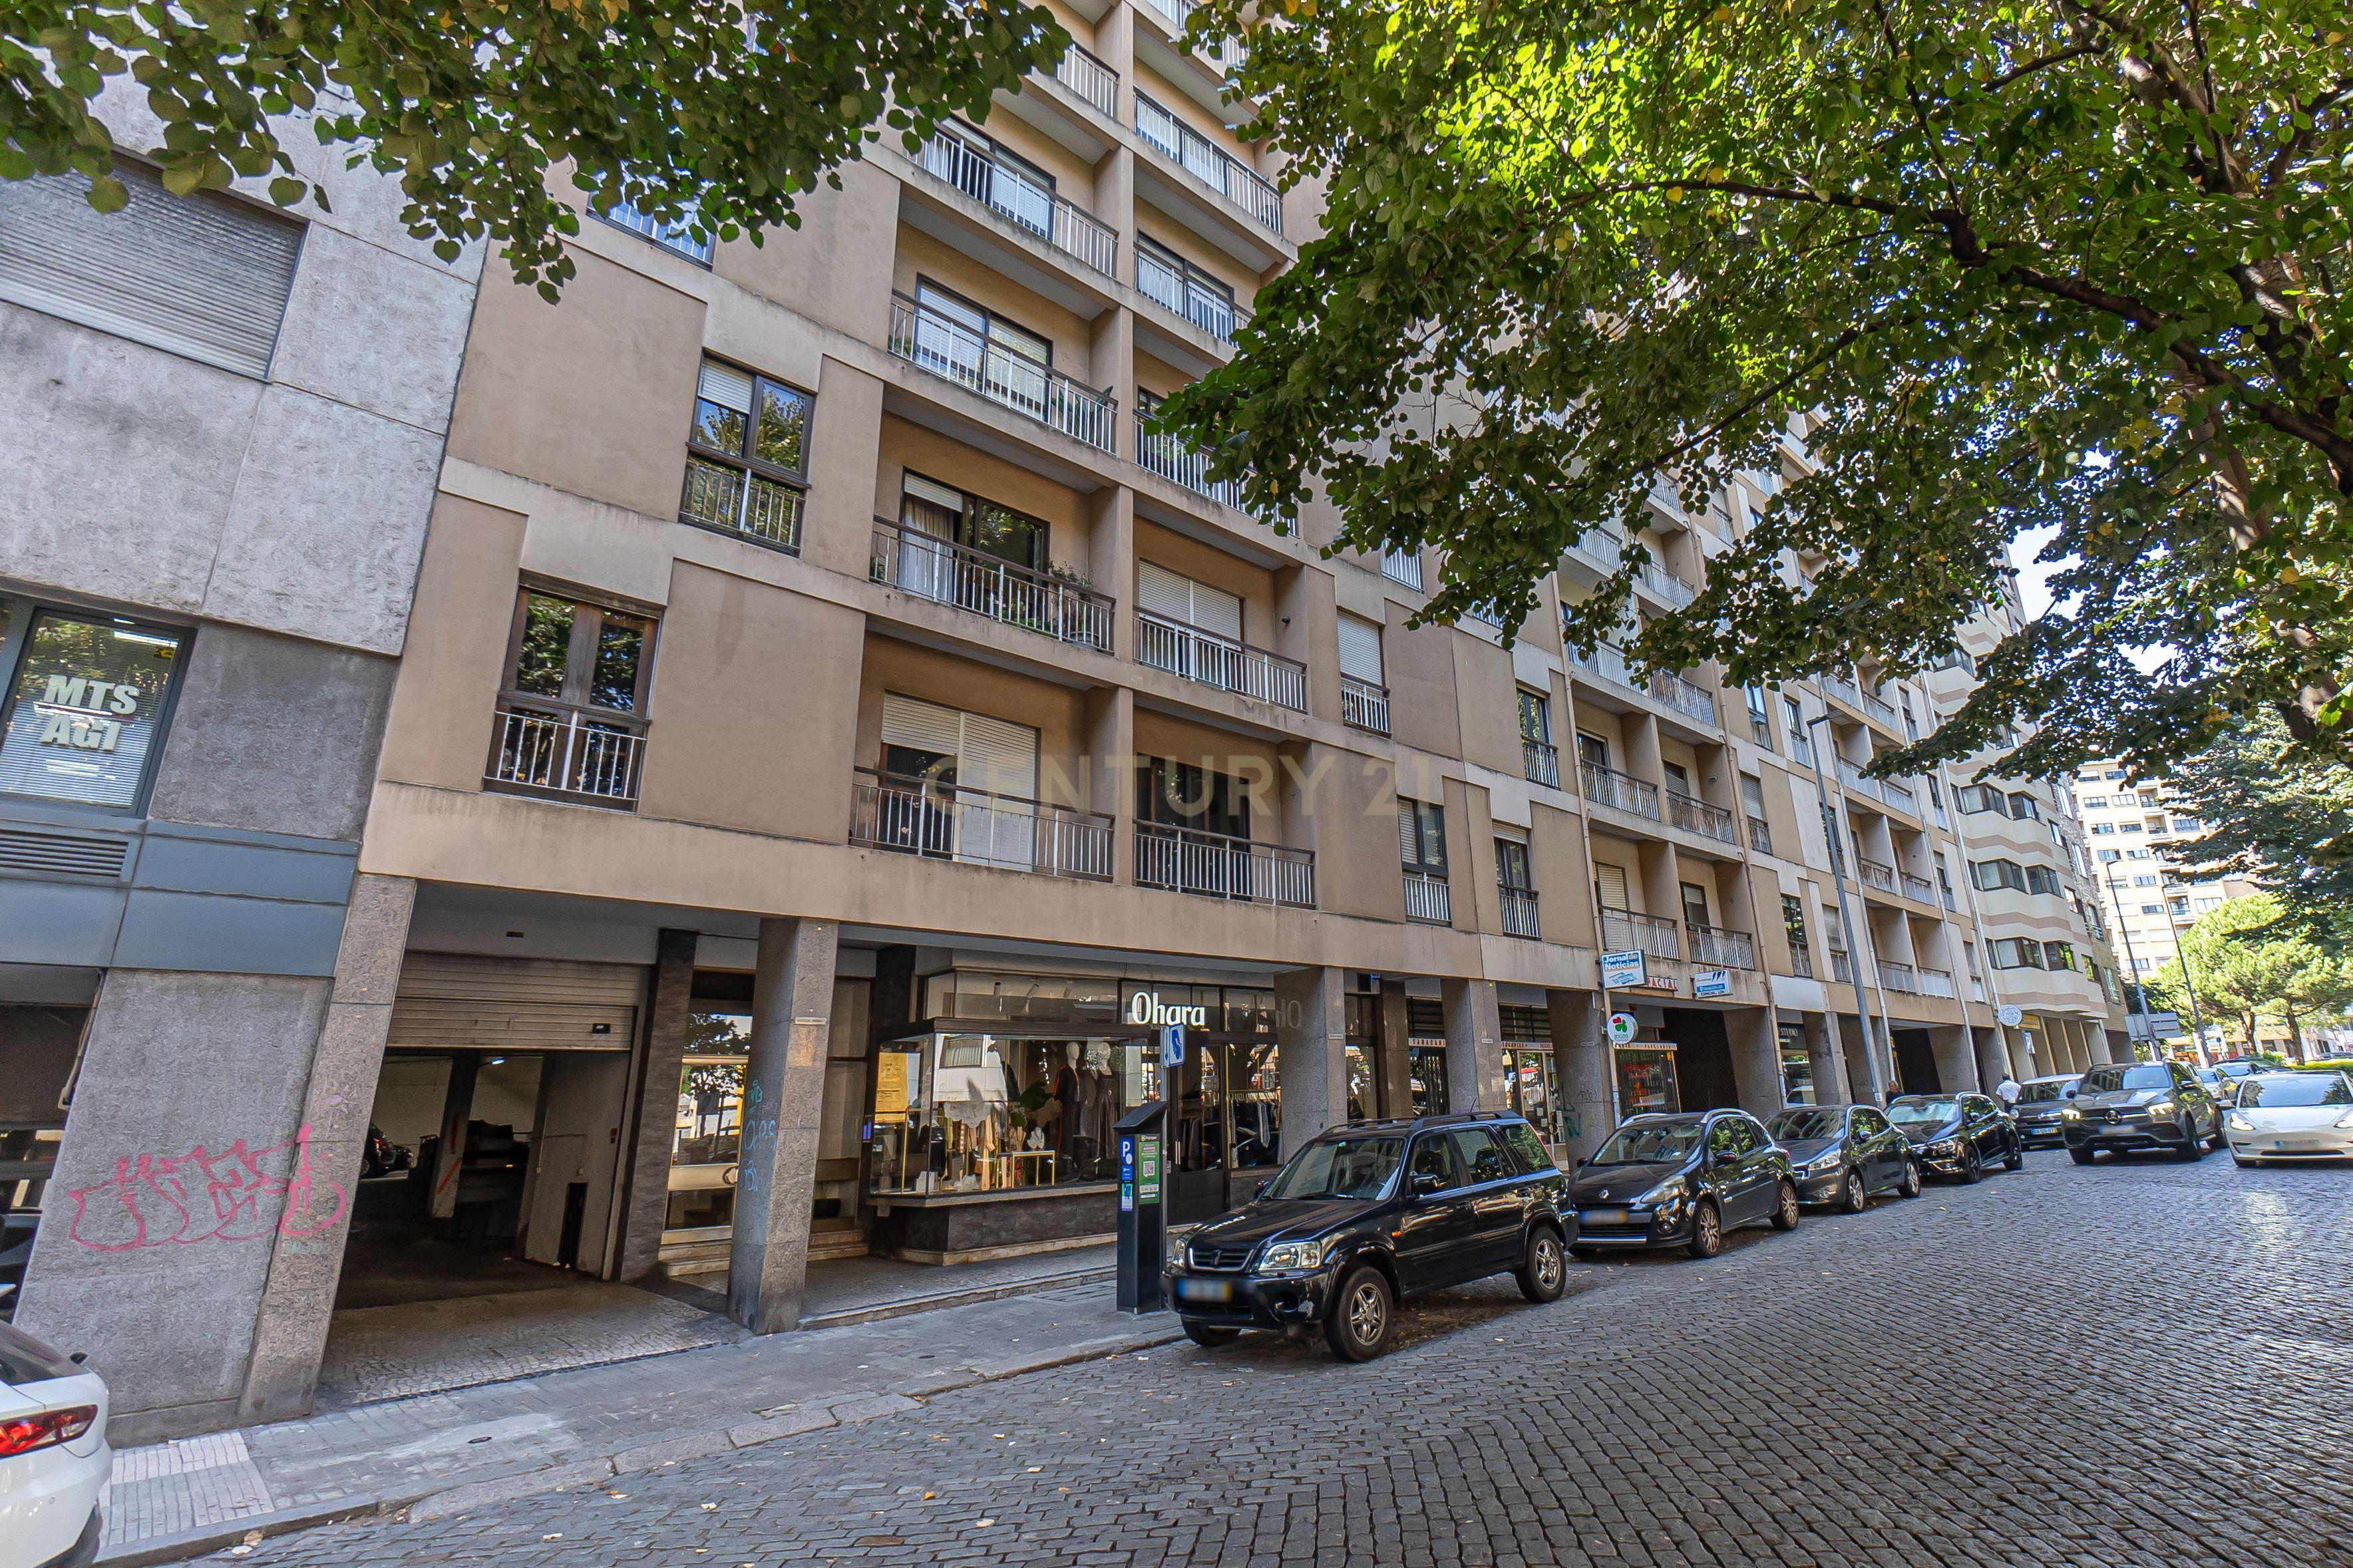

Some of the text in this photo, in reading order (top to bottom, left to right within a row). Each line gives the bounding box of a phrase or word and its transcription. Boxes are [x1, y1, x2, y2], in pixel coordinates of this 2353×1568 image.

[43, 674, 140, 714] MTS
[40, 714, 121, 752] AGI
[1604, 953, 1629, 963] Jornal
[1131, 991, 1205, 1026] Ohara
[1122, 1141, 1131, 1158] P
